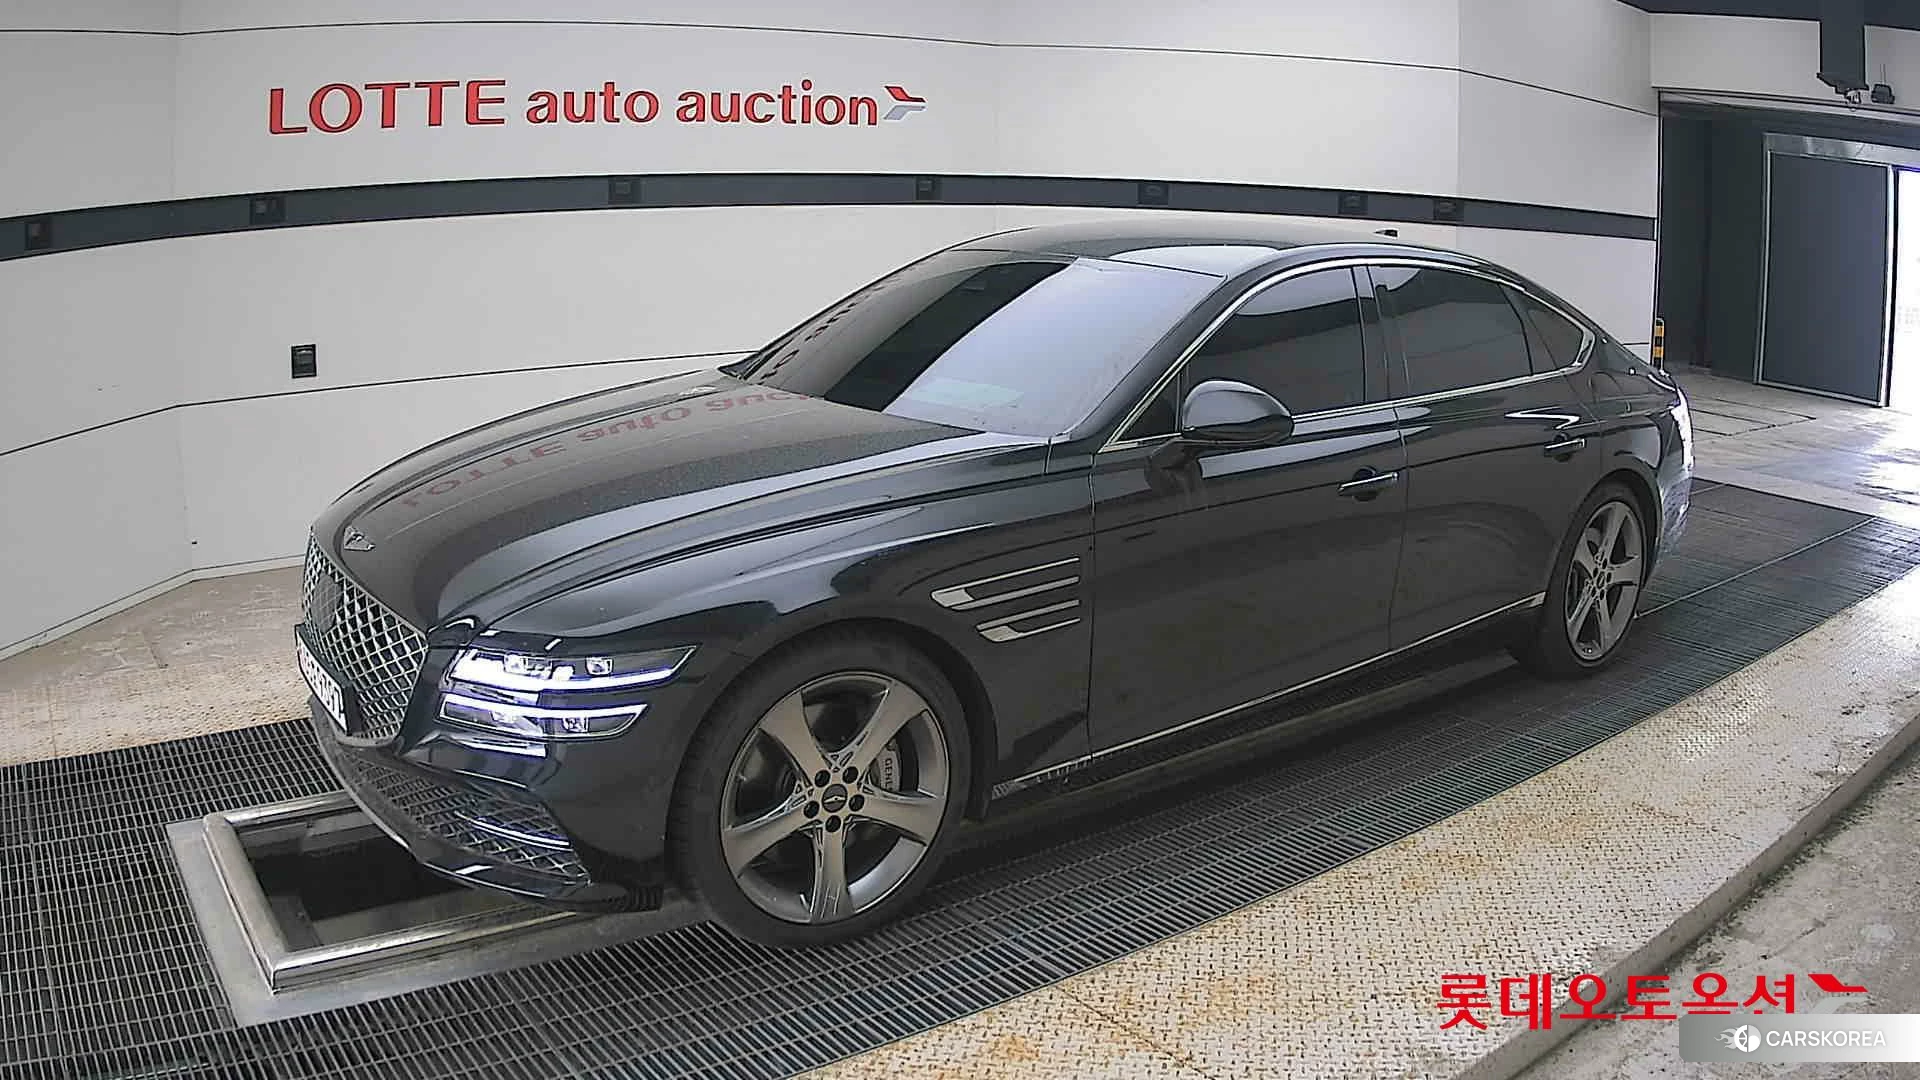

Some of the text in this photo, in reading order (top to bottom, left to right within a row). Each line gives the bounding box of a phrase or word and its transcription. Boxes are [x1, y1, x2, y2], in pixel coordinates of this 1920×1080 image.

[268, 79, 879, 135] LOTTE auto auction
